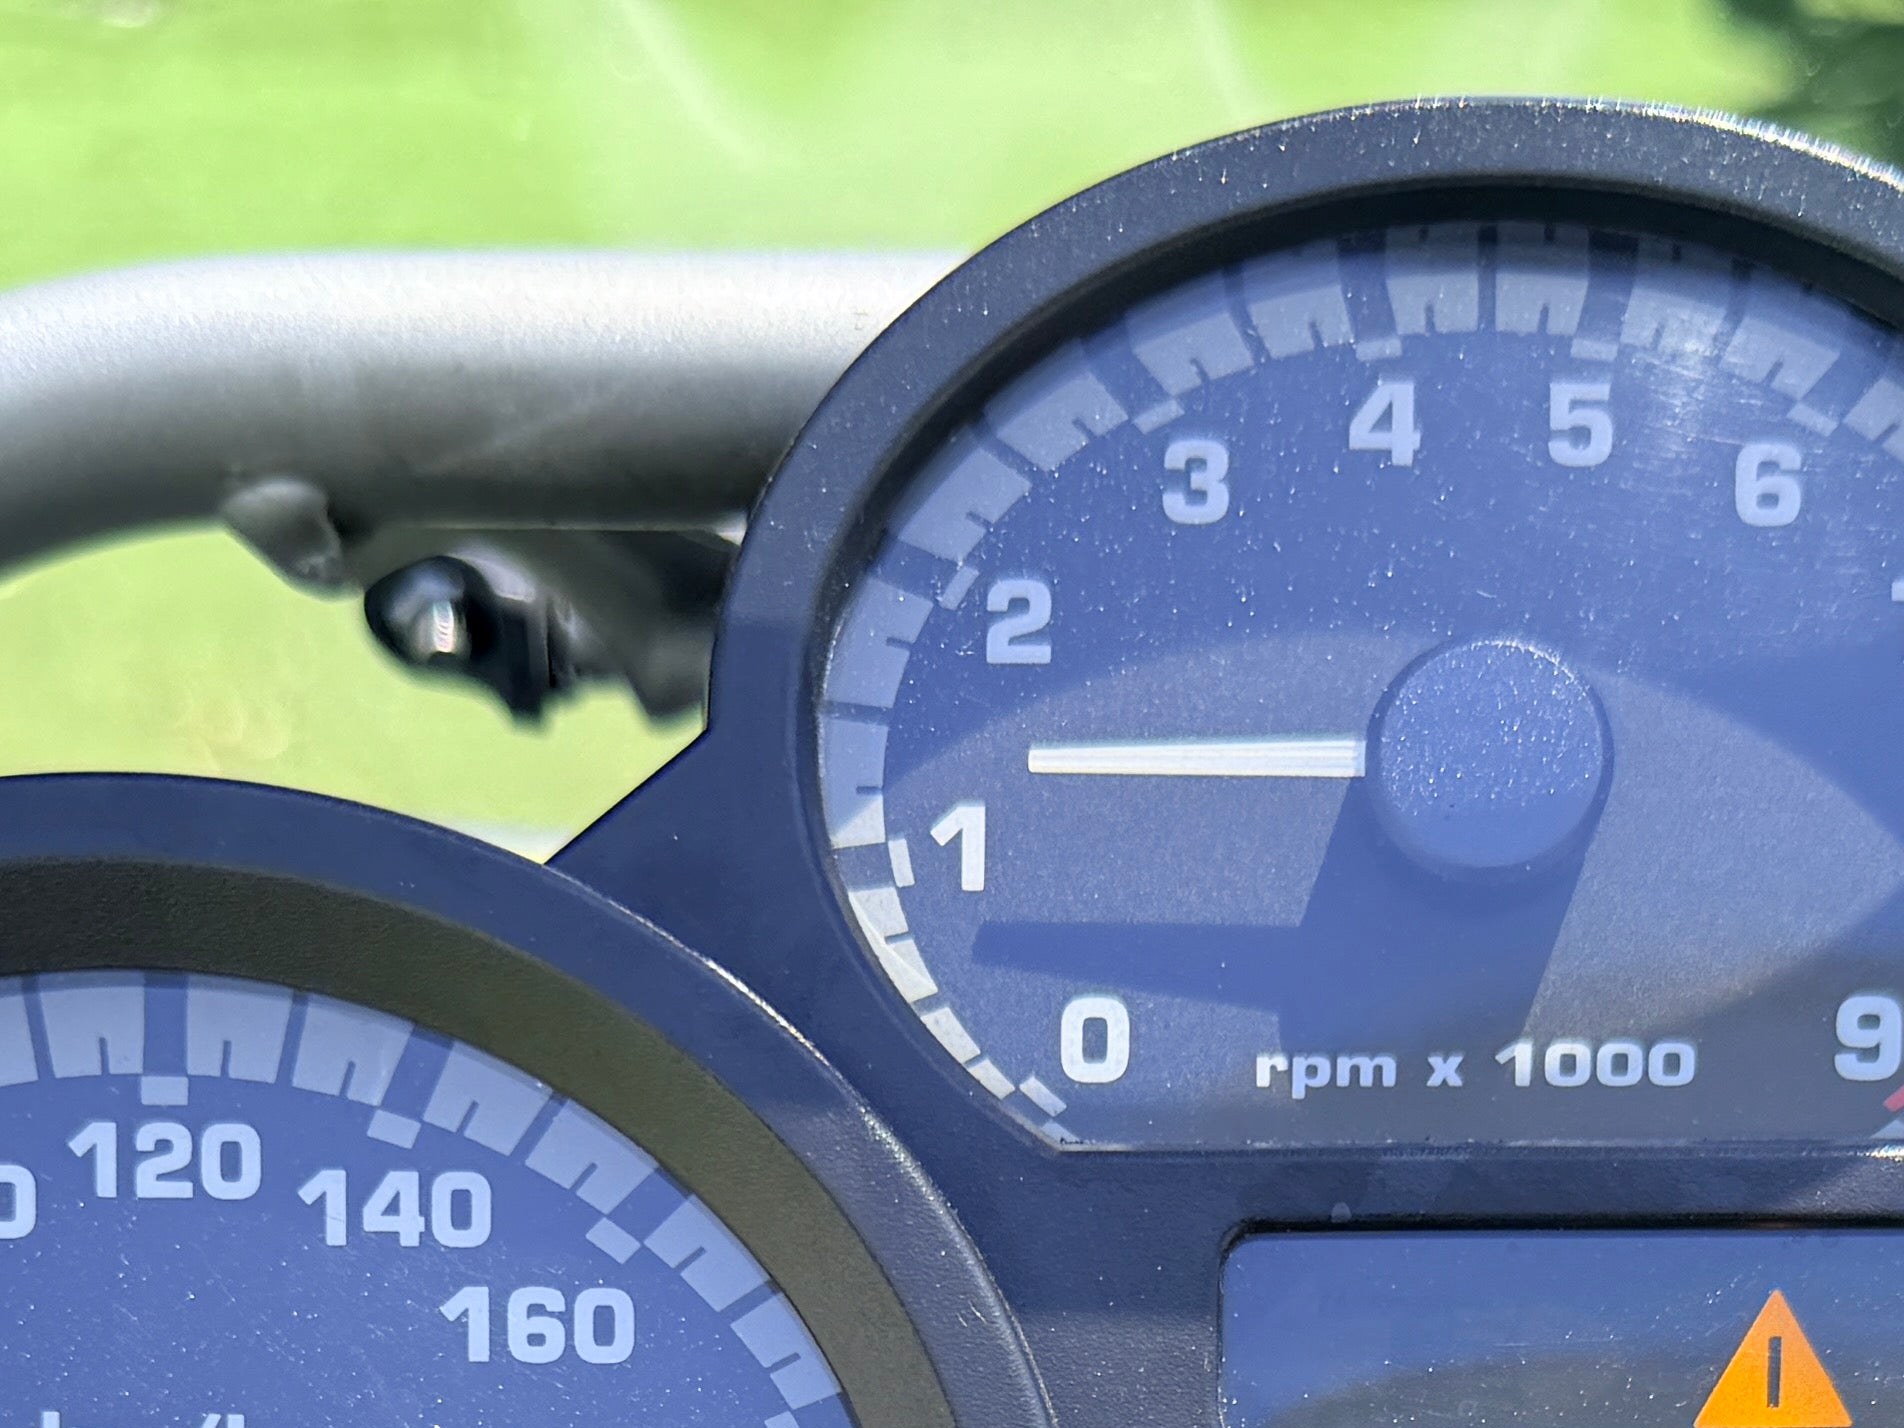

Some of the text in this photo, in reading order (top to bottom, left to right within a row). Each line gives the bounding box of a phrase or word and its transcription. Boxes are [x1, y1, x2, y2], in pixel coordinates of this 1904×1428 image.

[1348, 380, 1421, 467] 4
[1549, 382, 1615, 467] 5
[1162, 439, 1230, 525] 3
[1735, 441, 1802, 526] 6
[986, 579, 1052, 664] 2
[930, 805, 986, 892] 1
[1061, 996, 1130, 1083] 0
[1255, 1042, 1696, 1100] rpm x 1000
[1834, 995, 1903, 1081] 9
[68, 1122, 263, 1200] 120
[298, 1172, 494, 1248] 140
[440, 1286, 638, 1364] 160
